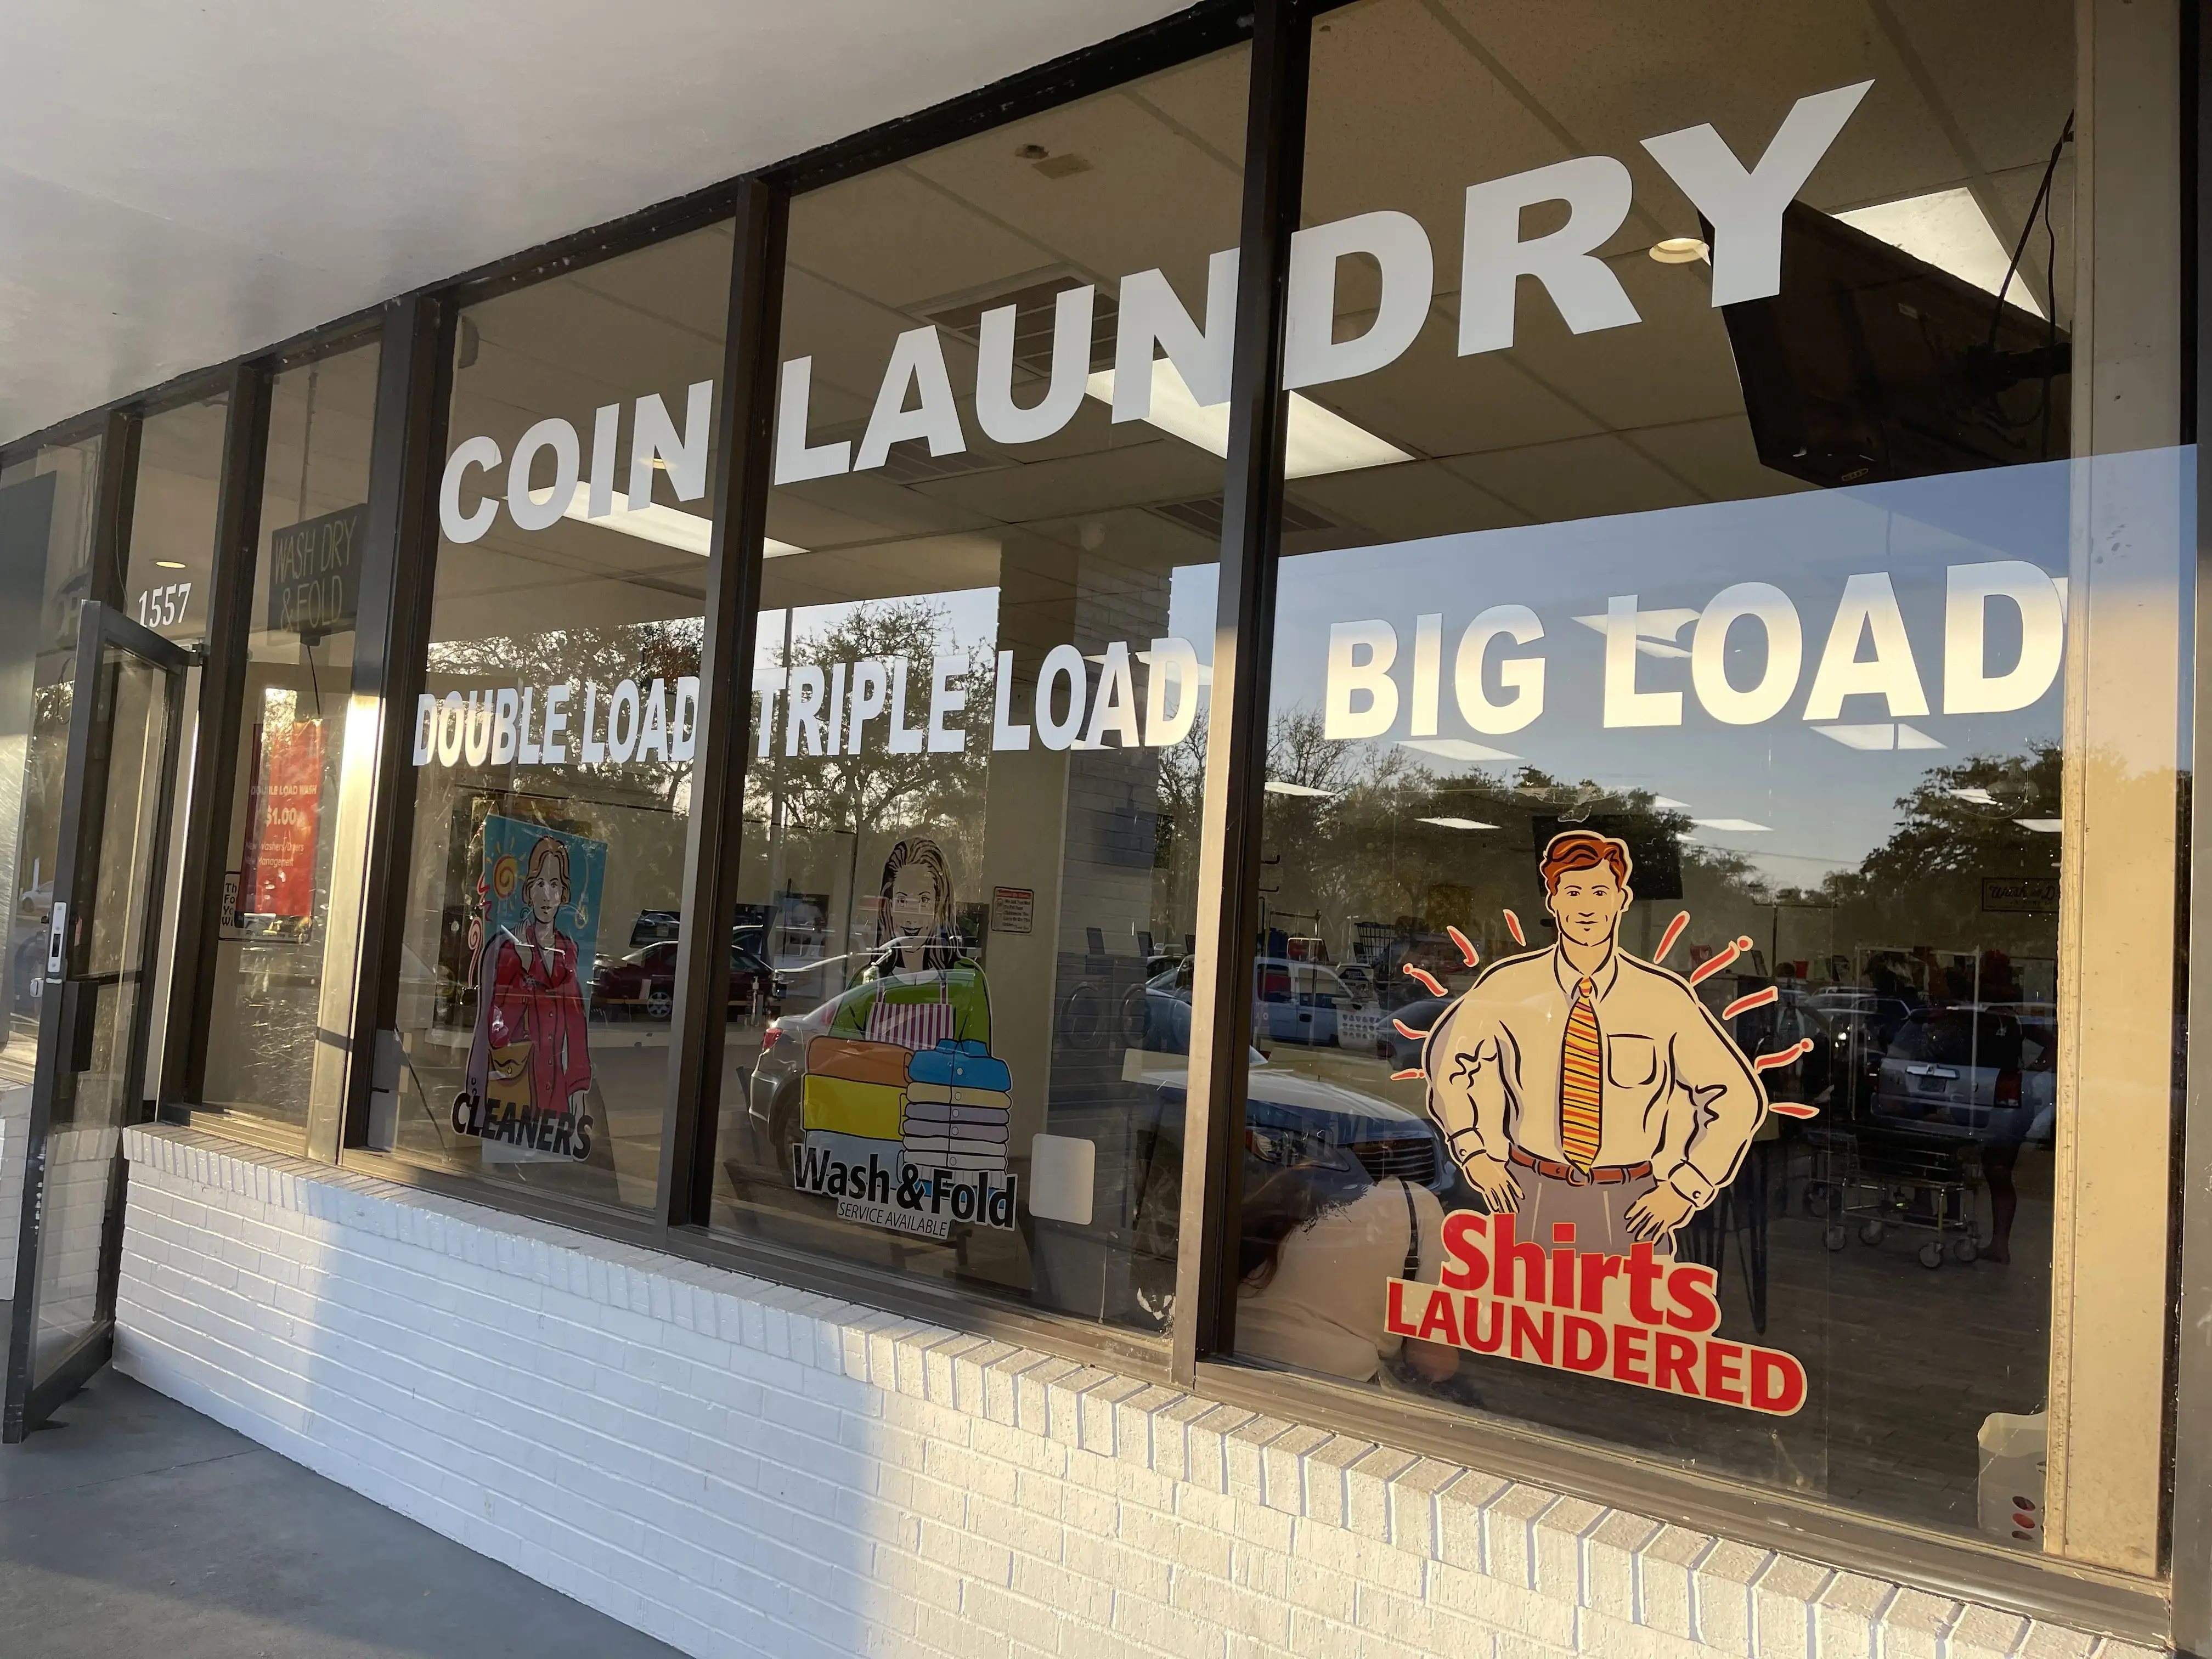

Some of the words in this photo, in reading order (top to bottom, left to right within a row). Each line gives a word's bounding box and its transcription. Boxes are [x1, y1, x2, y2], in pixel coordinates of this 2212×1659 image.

[439, 379, 713, 543] COIN
[774, 78, 1876, 484] LAUNDRY
[276, 528, 315, 584] WASH
[321, 515, 357, 572] DRY
[139, 583, 191, 628] 1557
[281, 588, 293, 632] &
[297, 575, 342, 630] FOLD
[1324, 604, 1545, 740] BIG
[1604, 561, 2063, 729] LOAD
[413, 685, 570, 767] DOUBLE
[581, 676, 700, 764] LOAD
[752, 653, 969, 757] TRIPLE
[992, 637, 1198, 751] LOAD
[266, 805, 297, 827] $1.00
[279, 786, 297, 795] LOAD
[299, 785, 317, 794] WASH
[224, 895, 235, 904] Fo
[225, 883, 236, 893] Th
[452, 1092, 594, 1159] CLEANERS
[793, 1145, 890, 1204] Wash
[896, 1163, 924, 1211] &
[932, 1169, 1016, 1228] Fold
[838, 1202, 884, 1223] SERVICE
[885, 1211, 948, 1237] AVAILABLE
[1442, 1212, 1718, 1333] Shirts
[1388, 1282, 1804, 1412] LAUNDERED
